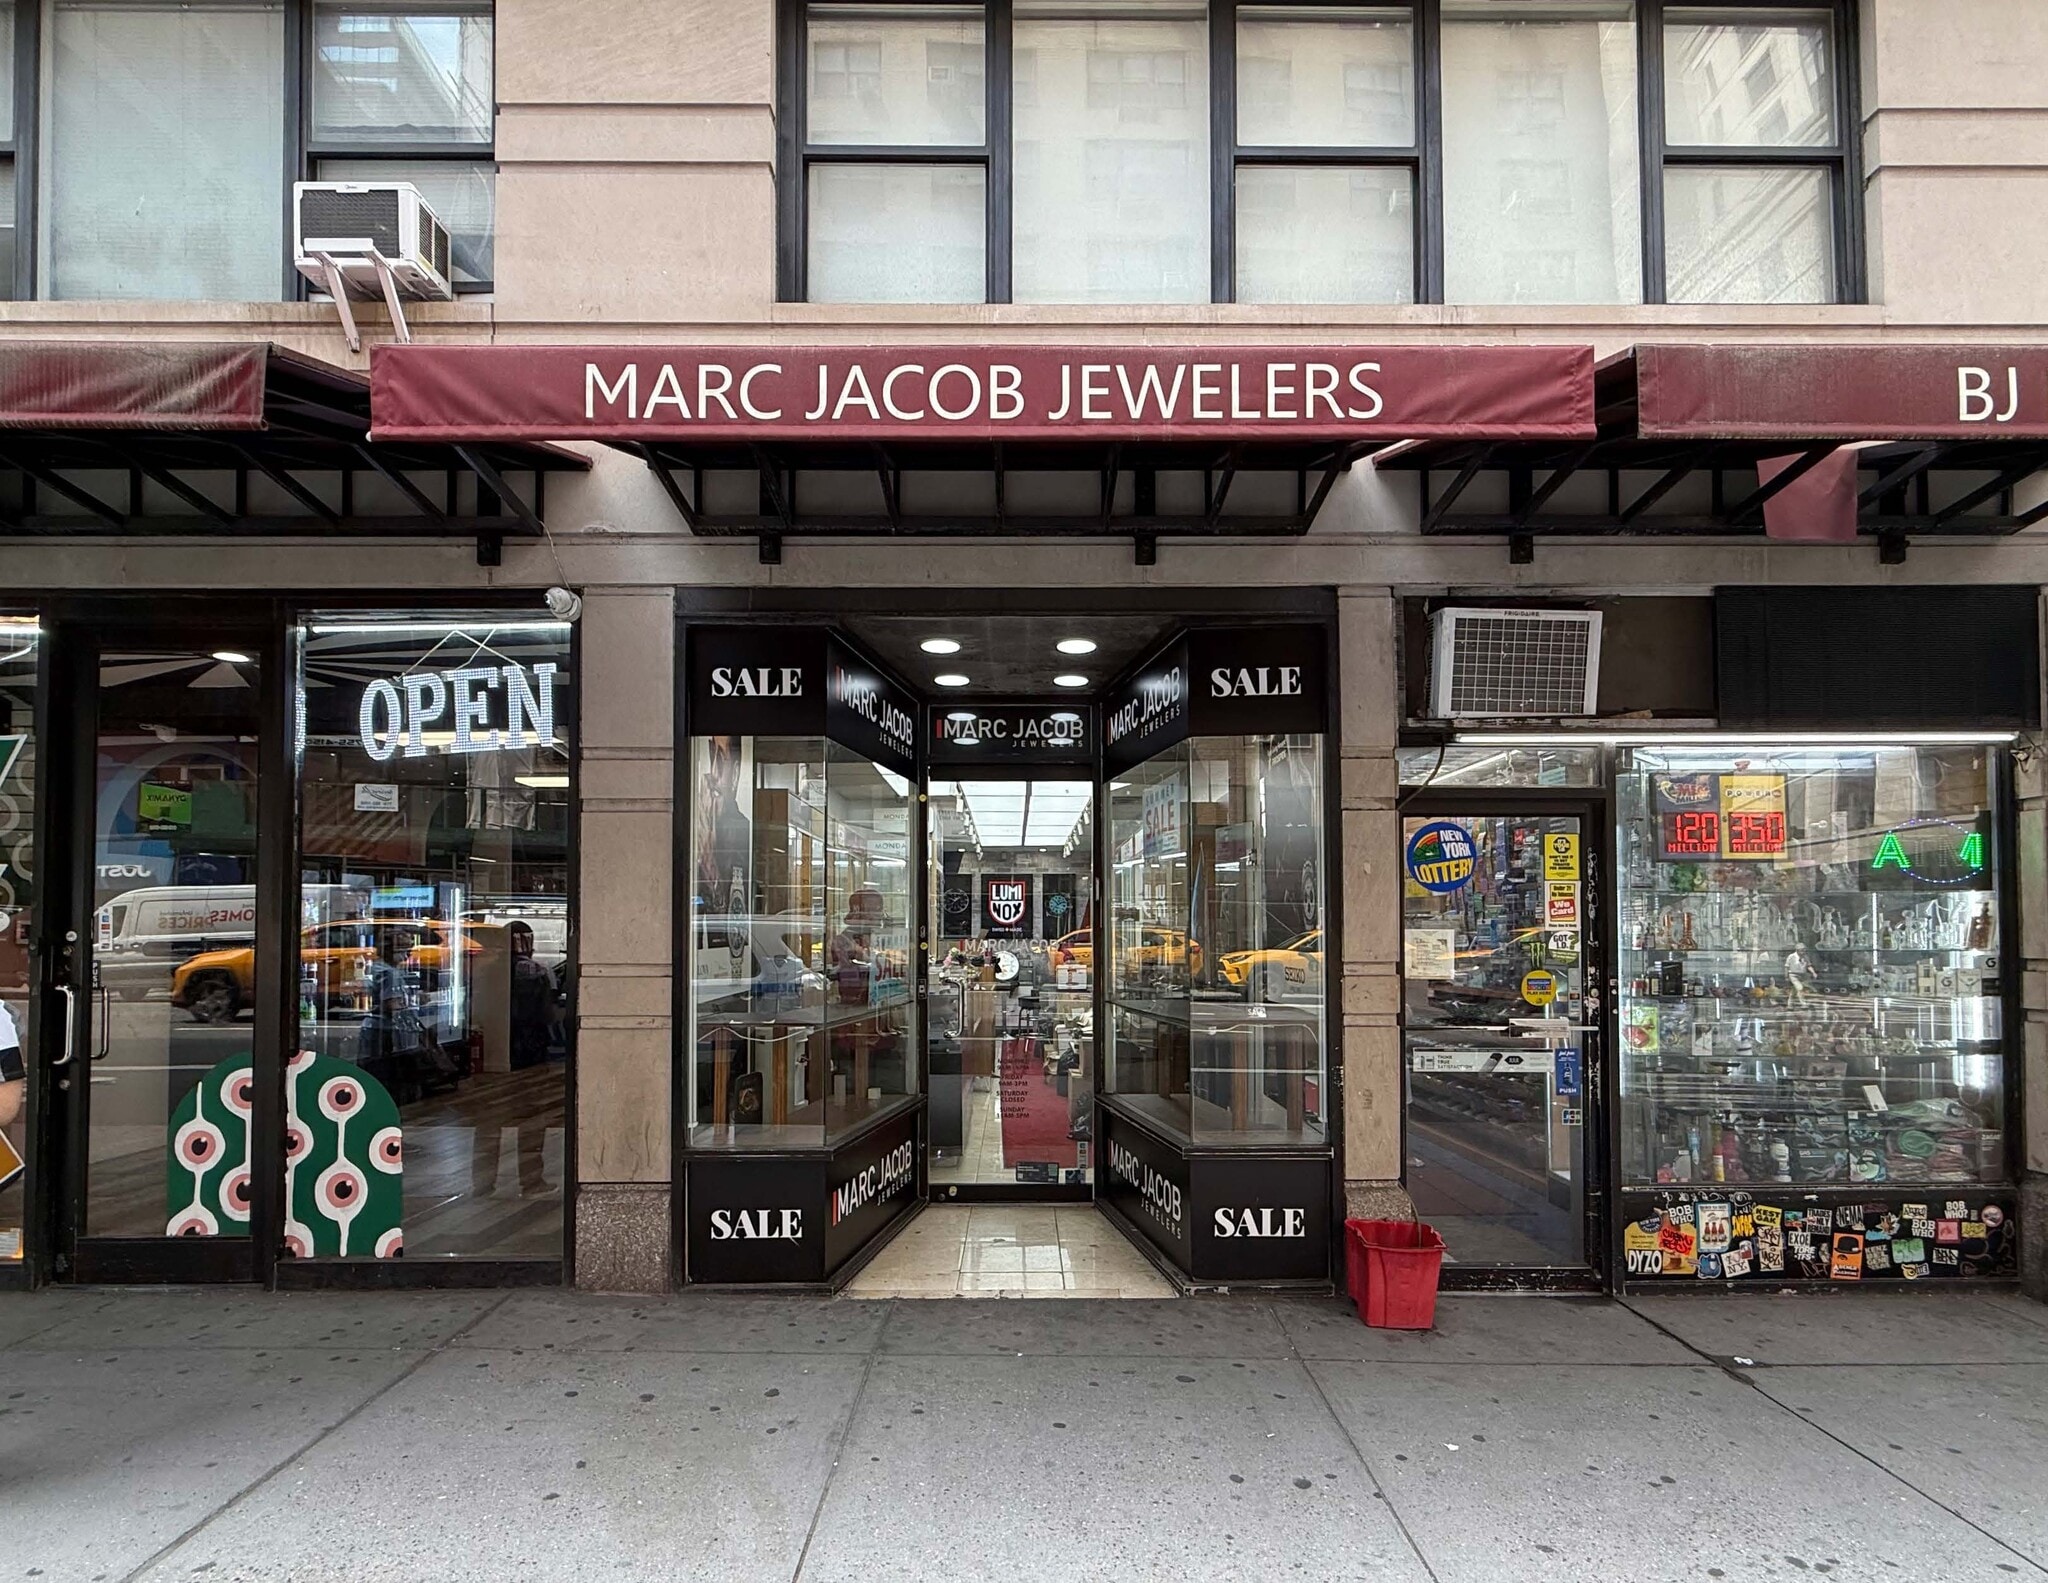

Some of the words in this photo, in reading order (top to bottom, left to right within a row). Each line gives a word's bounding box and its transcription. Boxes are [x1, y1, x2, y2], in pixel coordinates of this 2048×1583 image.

[584, 363, 782, 420] MARC
[805, 364, 1025, 420] JACOB
[1048, 362, 1384, 420] JEWELERS
[1957, 366, 2018, 422] BJ
[711, 667, 802, 697] SALE
[1211, 666, 1302, 698] SALE
[359, 663, 557, 761] OPEN
[840, 668, 878, 723] MARC
[879, 700, 913, 746] JACOB
[1110, 698, 1139, 744] MARC
[1140, 666, 1180, 723] JACOB
[944, 719, 1007, 738] MARC
[1012, 719, 1084, 738] JACOB
[1140, 704, 1181, 739] JEWELERS
[879, 731, 913, 760] JEWELERS
[1146, 799, 1175, 840] SALE
[1676, 813, 1718, 843] 120
[1731, 813, 1784, 843] 350
[1440, 829, 1464, 841] NEW
[1442, 842, 1471, 859] YORK
[1667, 843, 1717, 852] MILLION
[1733, 843, 1783, 852] MILLION
[1414, 857, 1474, 884] LOTTERY
[992, 884, 1022, 900] LUMI
[992, 903, 1022, 920] NOX
[1551, 907, 1574, 915] Card
[1554, 900, 1570, 908] We
[964, 939, 1007, 952] MARC
[1553, 934, 1568, 942] GOT
[837, 1165, 876, 1223] MARC
[878, 1140, 912, 1190] JACOB
[877, 1172, 912, 1206] JEWELERS
[1110, 1139, 1139, 1187] MARC
[1141, 1164, 1182, 1222] JACOB
[1668, 1204, 1692, 1217] BOB
[1756, 1208, 1780, 1217] KEST
[1944, 1209, 1968, 1219] WHO?
[1945, 1201, 1965, 1210] BOB
[710, 1209, 803, 1240] SALE
[1141, 1198, 1182, 1240] JEWELERS
[1214, 1207, 1305, 1238] SALE
[1670, 1214, 1693, 1225] WHO
[1756, 1215, 1776, 1224] GAK
[1912, 1219, 1935, 1229] BOB
[1912, 1228, 1934, 1238] WHO
[1793, 1246, 1816, 1254] TORE
[1628, 1250, 1662, 1273] DYZO
